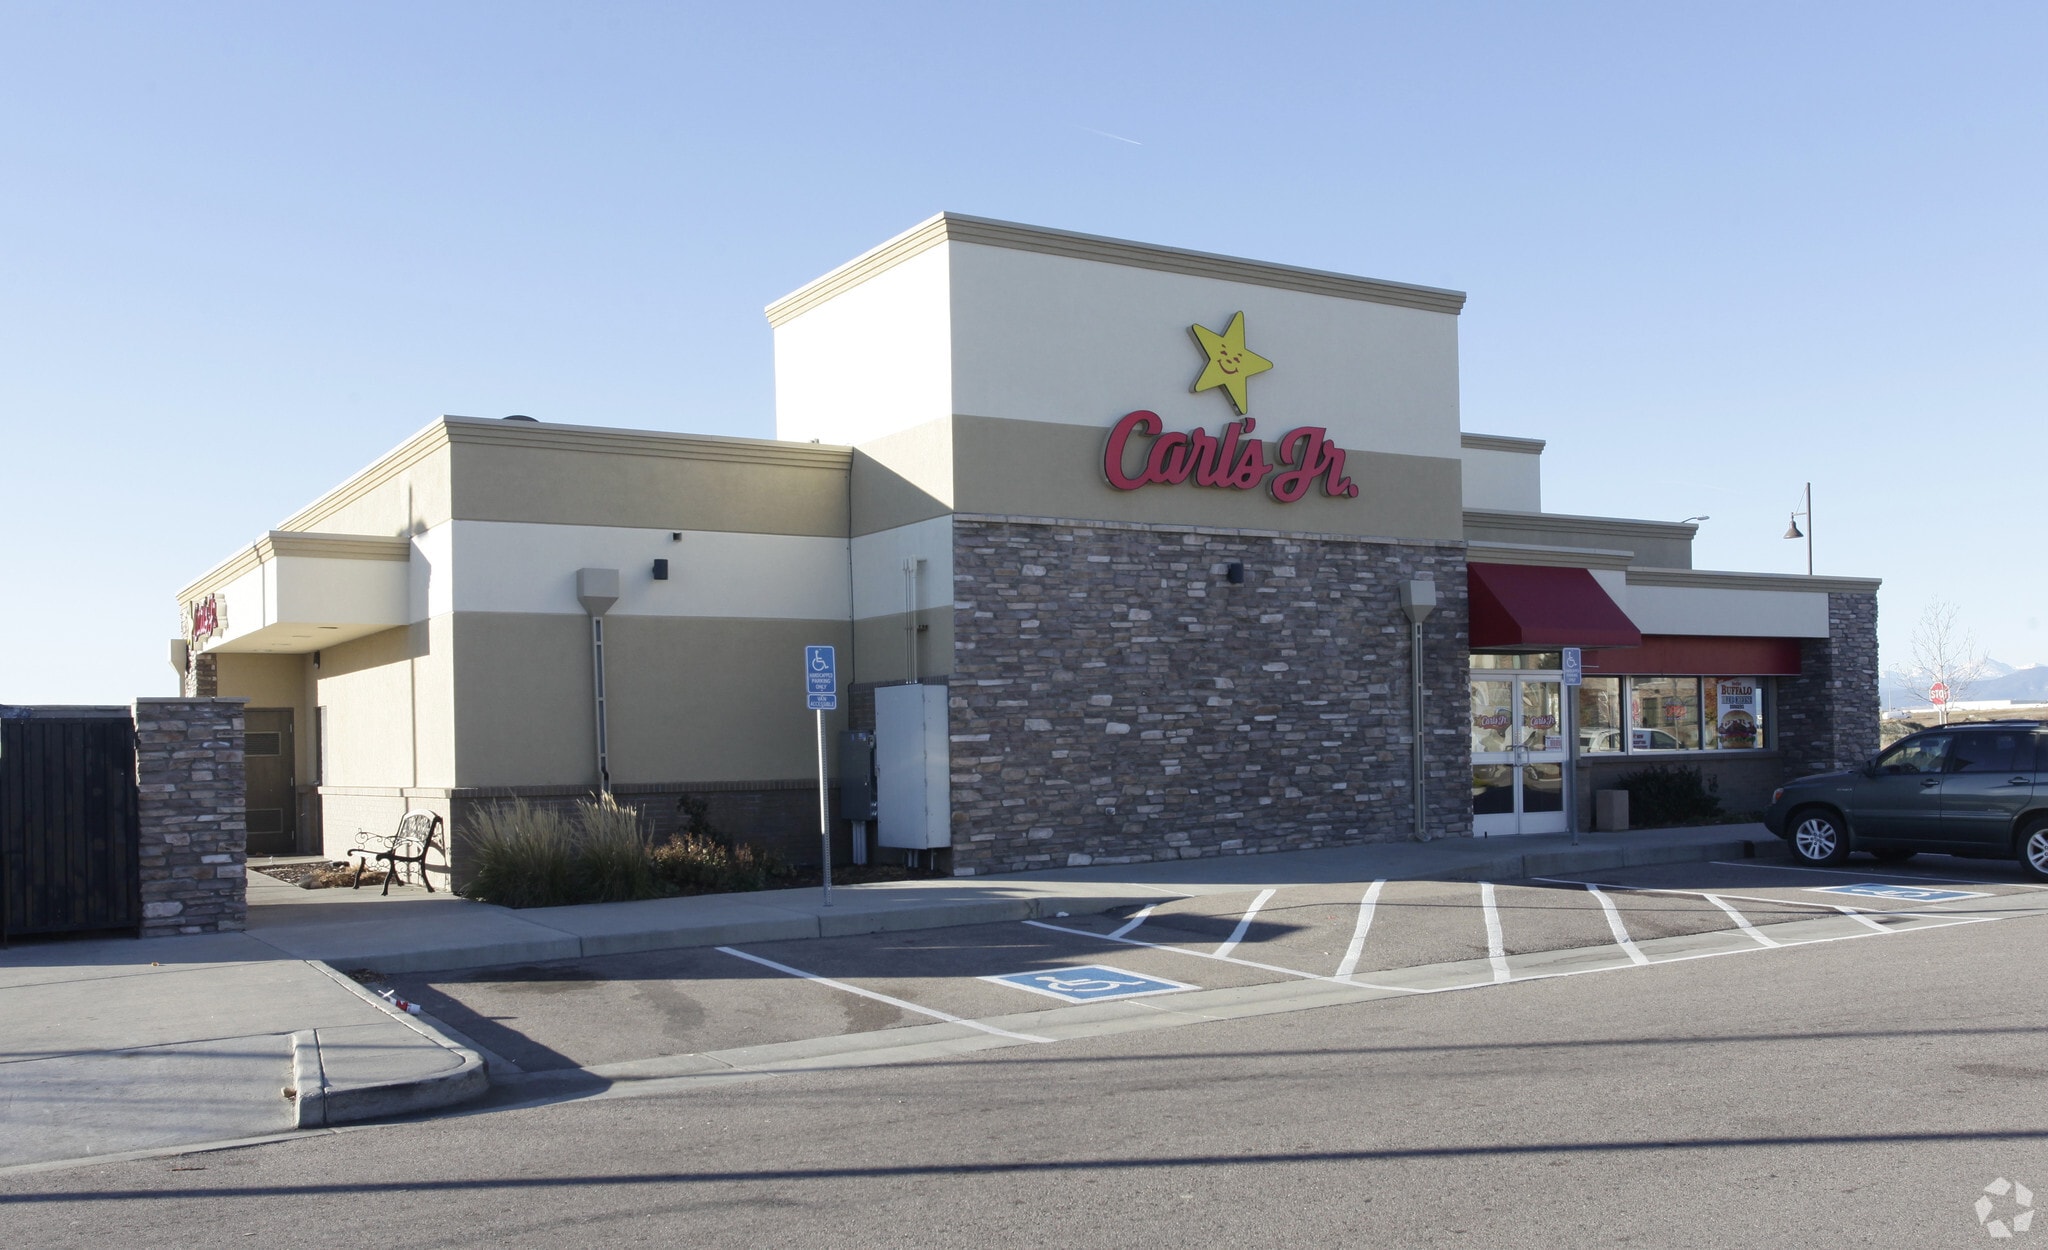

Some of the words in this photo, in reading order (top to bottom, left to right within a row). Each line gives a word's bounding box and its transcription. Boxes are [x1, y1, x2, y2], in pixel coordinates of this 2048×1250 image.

[1103, 410, 1273, 490] Carl's
[1271, 426, 1359, 503] Jr.
[1721, 684, 1752, 695] BUFFALO
